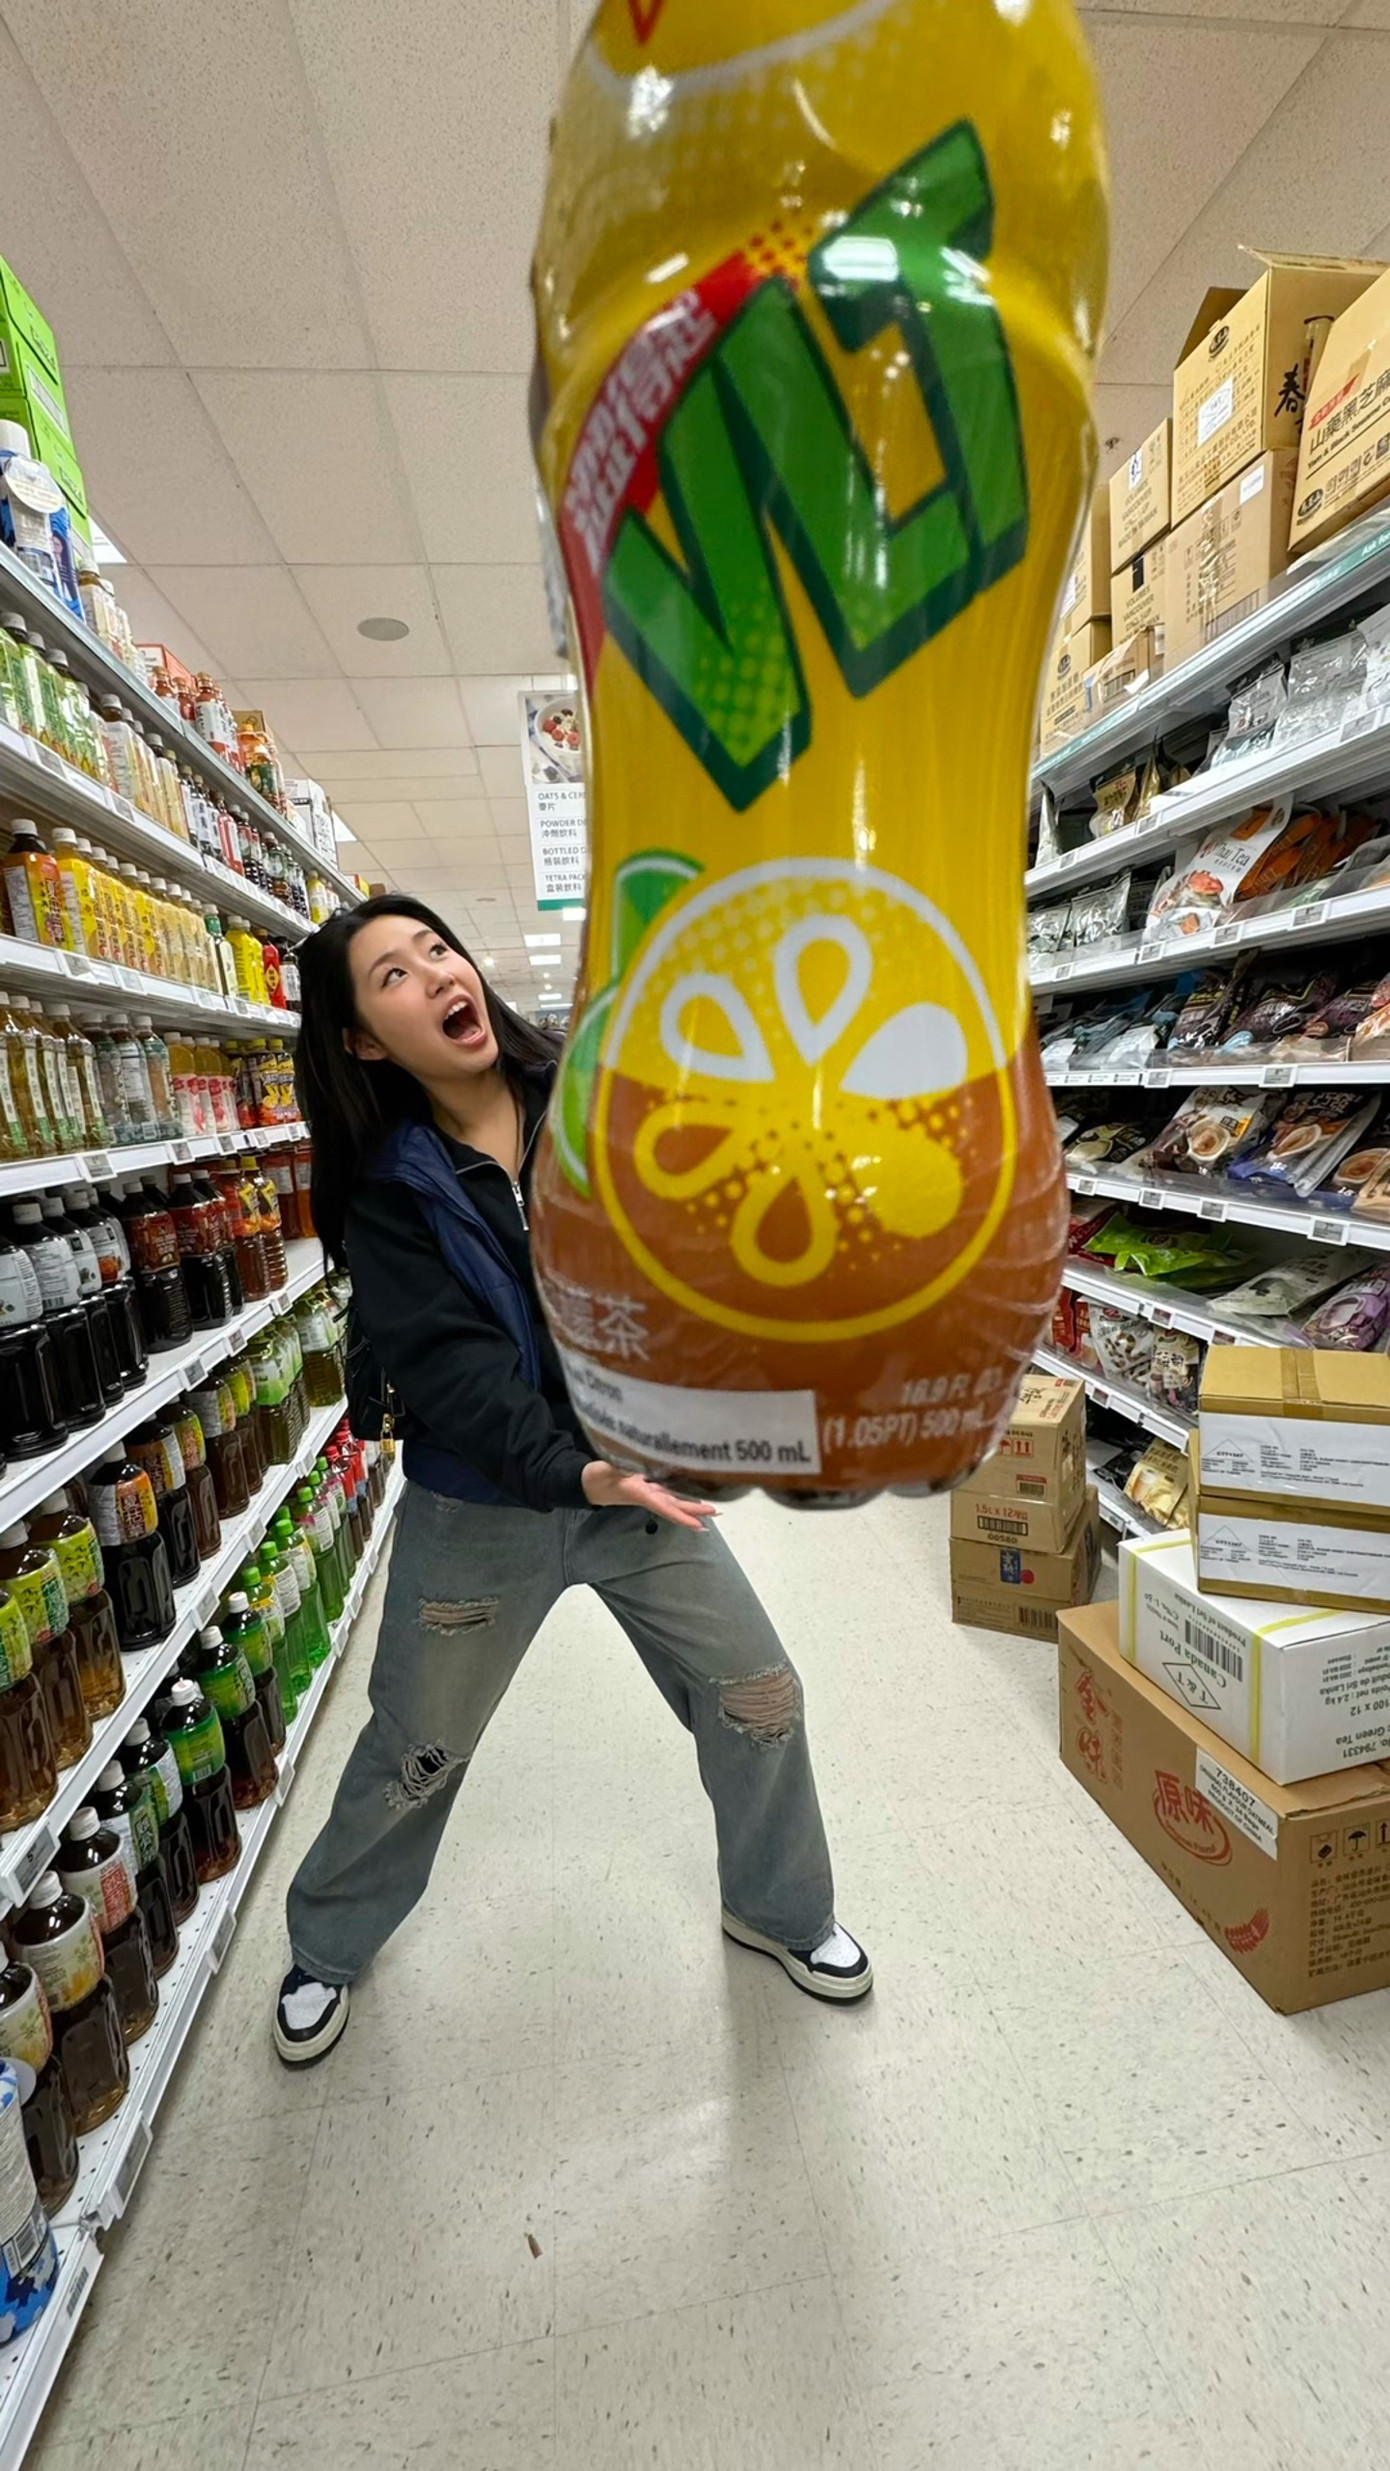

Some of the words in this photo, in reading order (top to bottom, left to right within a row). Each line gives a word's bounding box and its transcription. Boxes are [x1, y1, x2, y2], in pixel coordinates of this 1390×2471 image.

[538, 791, 560, 801] OATS
[561, 791, 567, 801] &
[540, 820, 575, 828] POWDER
[542, 847, 577, 856] BOTTLED
[545, 874, 567, 882] TETRA
[822, 1411, 917, 1455] (1.05PT)
[920, 1407, 961, 1439] 500
[734, 1439, 772, 1463] 500
[777, 1440, 812, 1463] mL
[1173, 1592, 1196, 1612] Lanka
[1217, 1621, 1247, 1648] Product
[1159, 1629, 1182, 1656] Port
[1184, 1650, 1228, 1689] Canada
[1176, 1671, 1186, 1686] T
[1187, 1678, 1198, 1694] &
[1345, 1679, 1358, 1691] Sri
[1319, 1682, 1346, 1696] Lanka
[1199, 1689, 1209, 1705] T
[1324, 1695, 1337, 1706] kg
[1349, 1705, 1362, 1718] 12
[1373, 1698, 1390, 1712] 100
[1335, 1734, 1354, 1746] Tea
[1356, 1726, 1386, 1741] Green
[1342, 1740, 1377, 1759] 794331
[1215, 1767, 1257, 1807] 738407
[1154, 1769, 1214, 1835] 原味
[1246, 1806, 1274, 1836] OATMEAL
